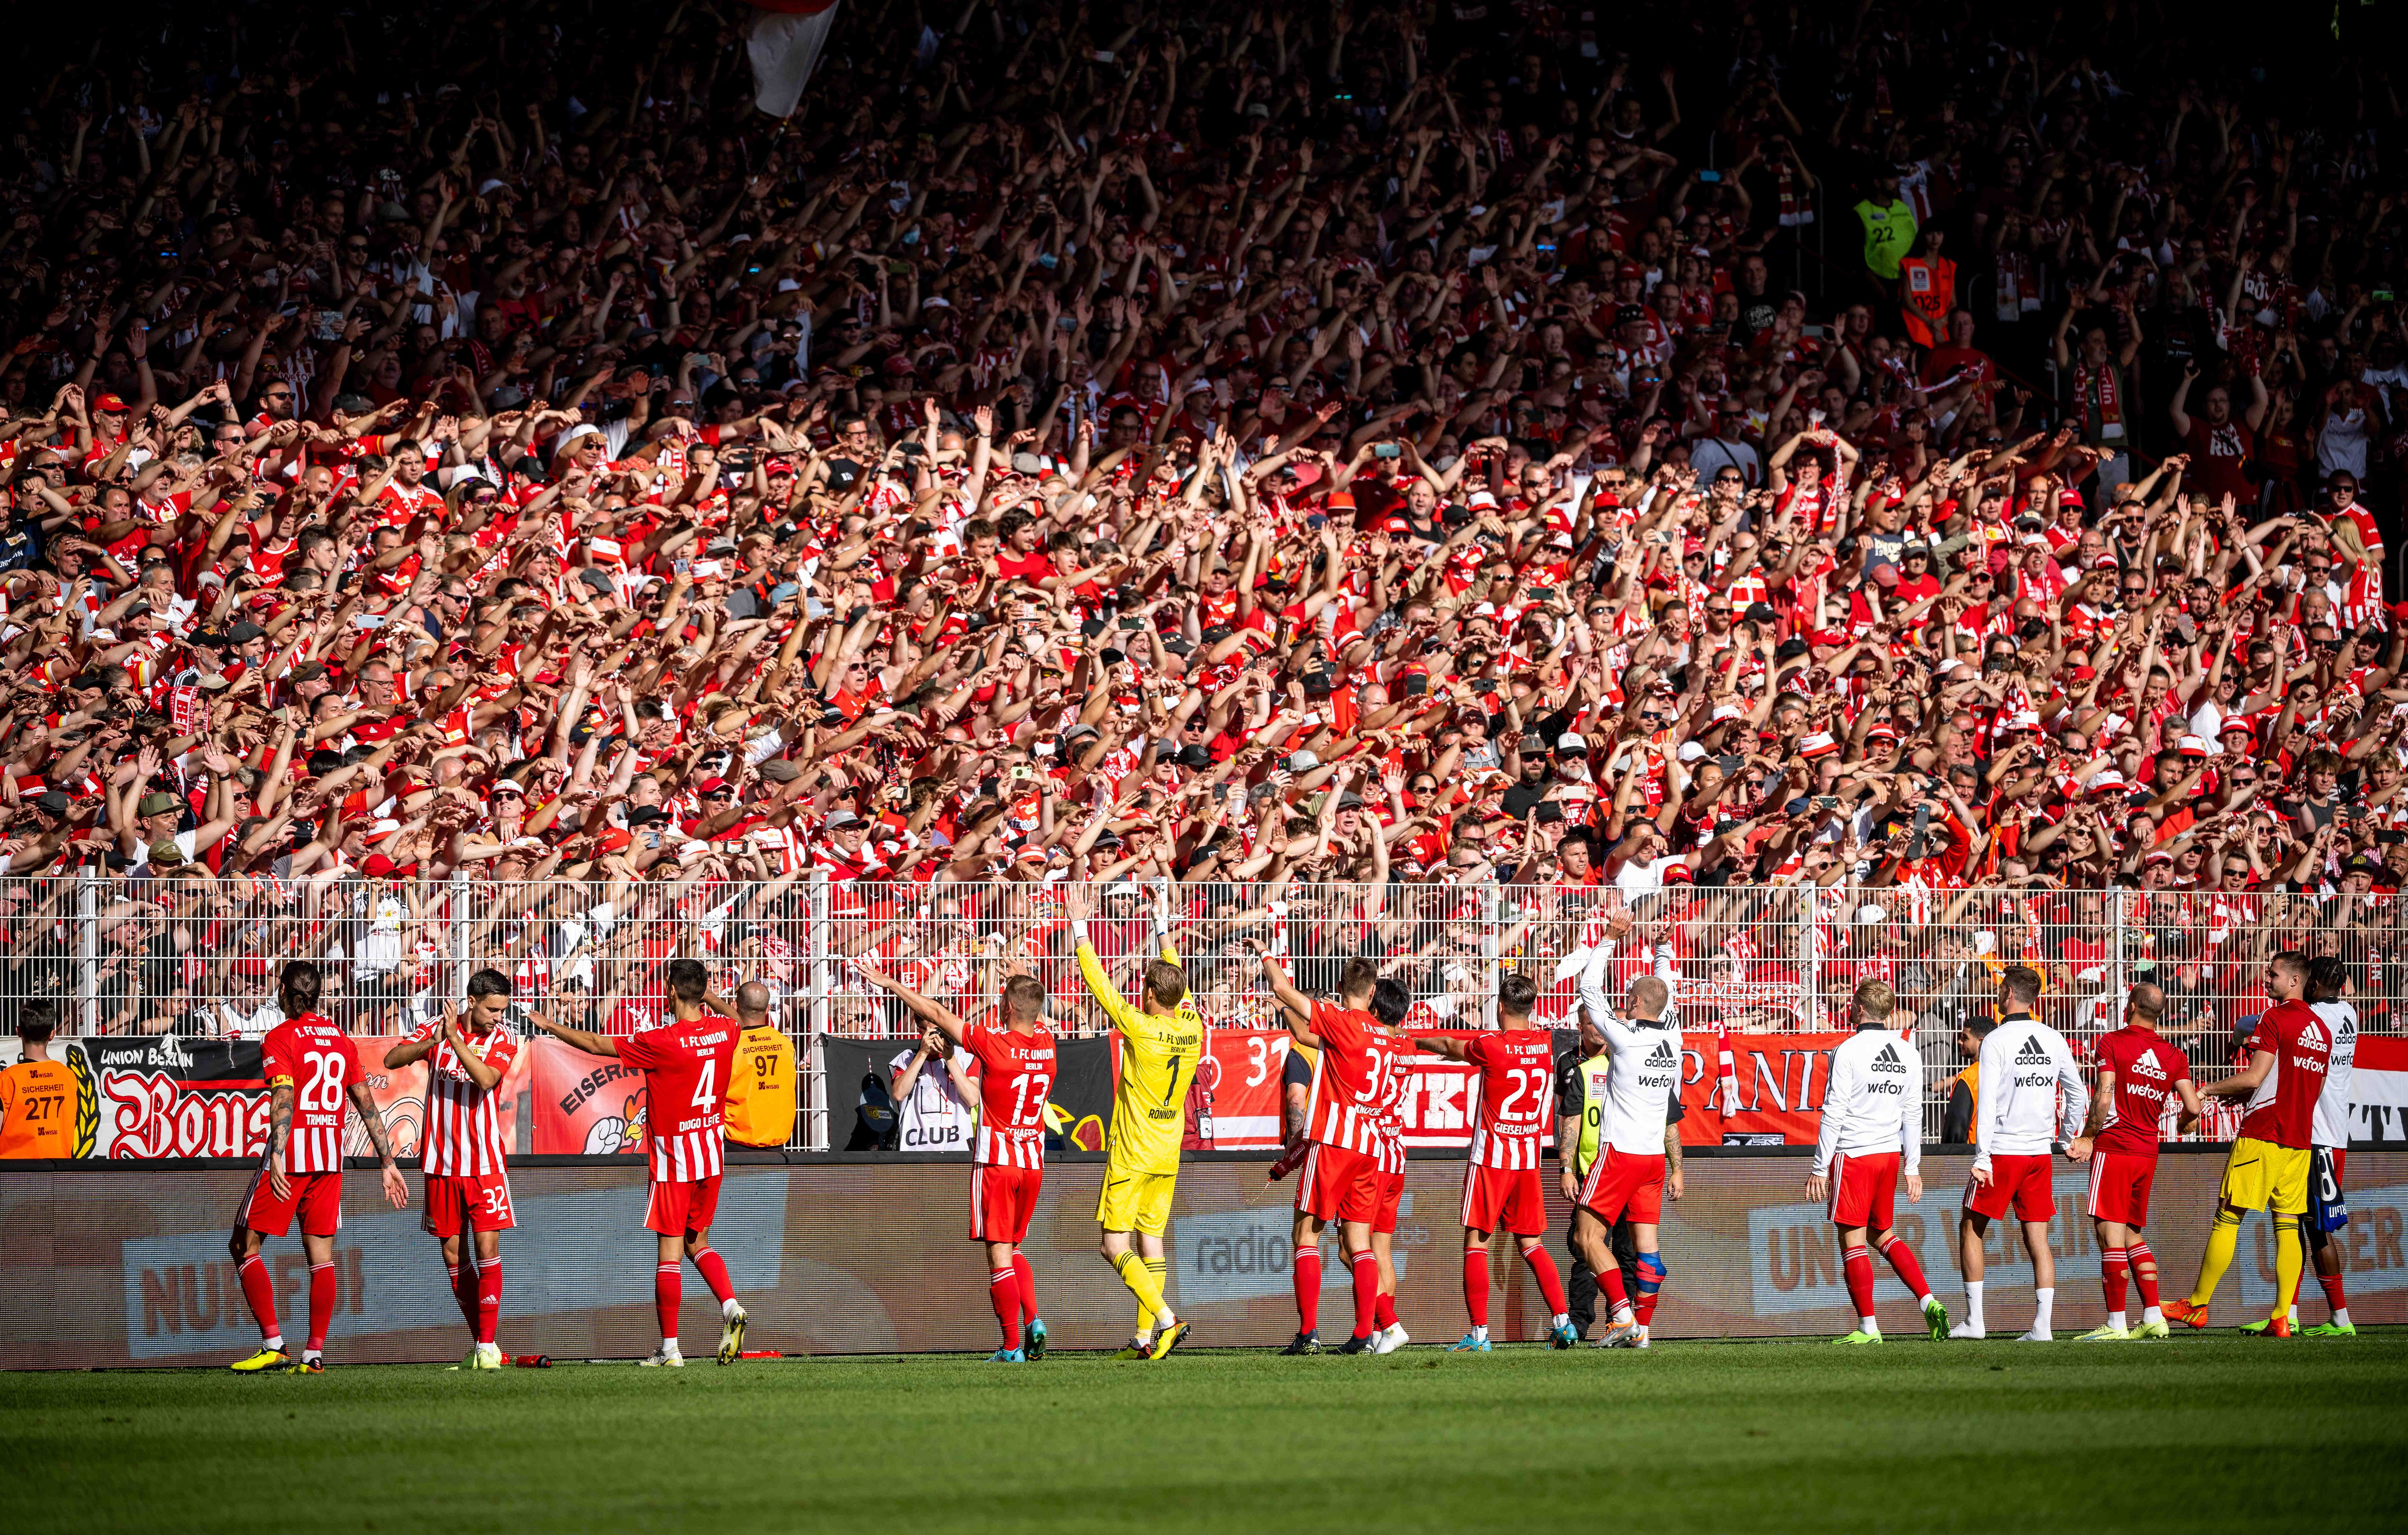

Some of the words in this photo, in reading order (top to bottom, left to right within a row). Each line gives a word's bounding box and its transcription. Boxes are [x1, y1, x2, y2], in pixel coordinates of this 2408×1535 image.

[1874, 226, 1895, 242] 22
[305, 1027, 315, 1036] FC
[316, 1027, 340, 1037] UNION
[689, 1035, 701, 1047] FC
[701, 1031, 728, 1045] UNION
[1167, 1034, 1175, 1043] FC
[1177, 1035, 1197, 1045] UNION
[742, 1044, 783, 1054] SICHERHEIT
[1373, 1037, 1387, 1046] BERLIN
[1514, 1045, 1523, 1055] FC
[1525, 1044, 1548, 1055] UNION
[2297, 1036, 2327, 1052] adidas
[100, 1049, 143, 1066] UNION
[697, 1047, 715, 1057] BERLIN
[1019, 1048, 1029, 1059] FC
[1031, 1048, 1054, 1060] UNION
[2015, 1054, 2051, 1065] adidas
[755, 1055, 778, 1077] 97
[1645, 1057, 1677, 1067] adidas
[1871, 1062, 1906, 1073] adidas
[2294, 1056, 2325, 1073] wefox
[300, 1050, 346, 1111] 28
[1163, 1055, 1181, 1106] 1
[1354, 1048, 1392, 1102] 31
[2014, 1073, 2053, 1087] wefox
[2131, 1065, 2167, 1080] addas
[22, 1084, 64, 1094] SICHERHEIT
[691, 1059, 716, 1114] 4
[1639, 1075, 1674, 1087] wefox
[1868, 1080, 1904, 1095] wefox
[1010, 1073, 1050, 1125] 13
[1500, 1068, 1547, 1121] 23
[2127, 1083, 2165, 1101] wefox
[24, 1096, 65, 1120] 277
[106, 1068, 270, 1158] Boys
[1148, 1108, 1177, 1120] RÖNNOW
[1355, 1104, 1384, 1117] KNOCHE
[679, 1116, 708, 1132] DIOGO
[905, 1125, 960, 1147] CLUB
[483, 1185, 508, 1214] 32
[1196, 1227, 1286, 1275] radio
